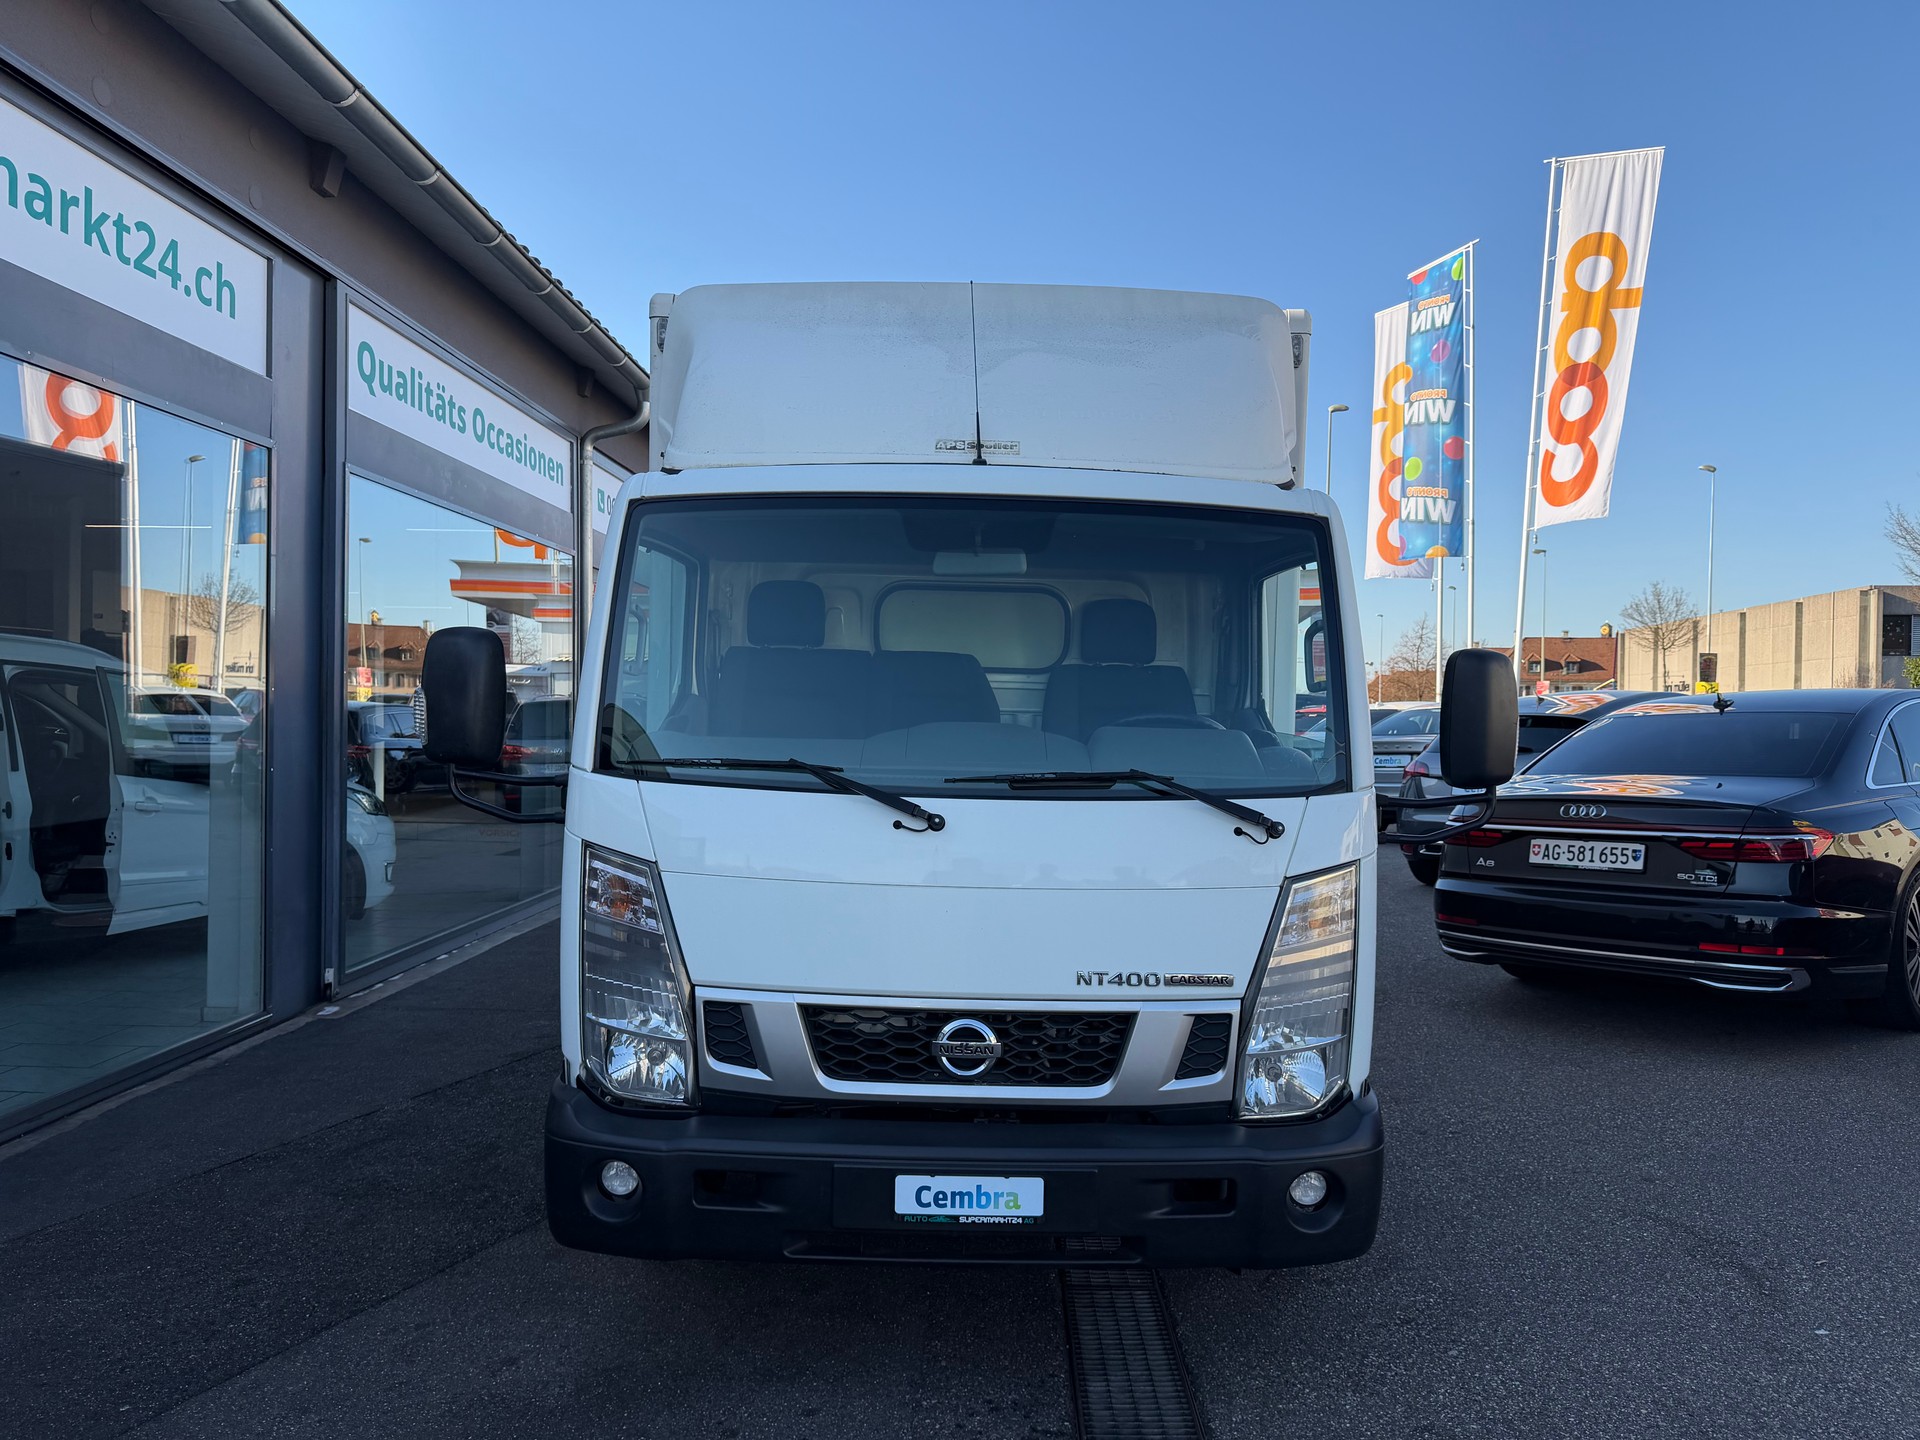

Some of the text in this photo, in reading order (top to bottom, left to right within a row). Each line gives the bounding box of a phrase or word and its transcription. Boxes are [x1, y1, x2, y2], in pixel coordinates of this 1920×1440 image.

[1541, 232, 1644, 507] coop
[357, 341, 564, 486] Qualitäts Occasionen
[936, 441, 965, 450] APS
[1374, 756, 1402, 765] Cembra
[1476, 857, 1495, 867] A8
[1076, 971, 1230, 987] NT400 CABSTAR
[939, 1045, 995, 1056] NISSAN
[914, 1184, 1022, 1210] Cembra
[904, 1215, 928, 1223] AUTO
